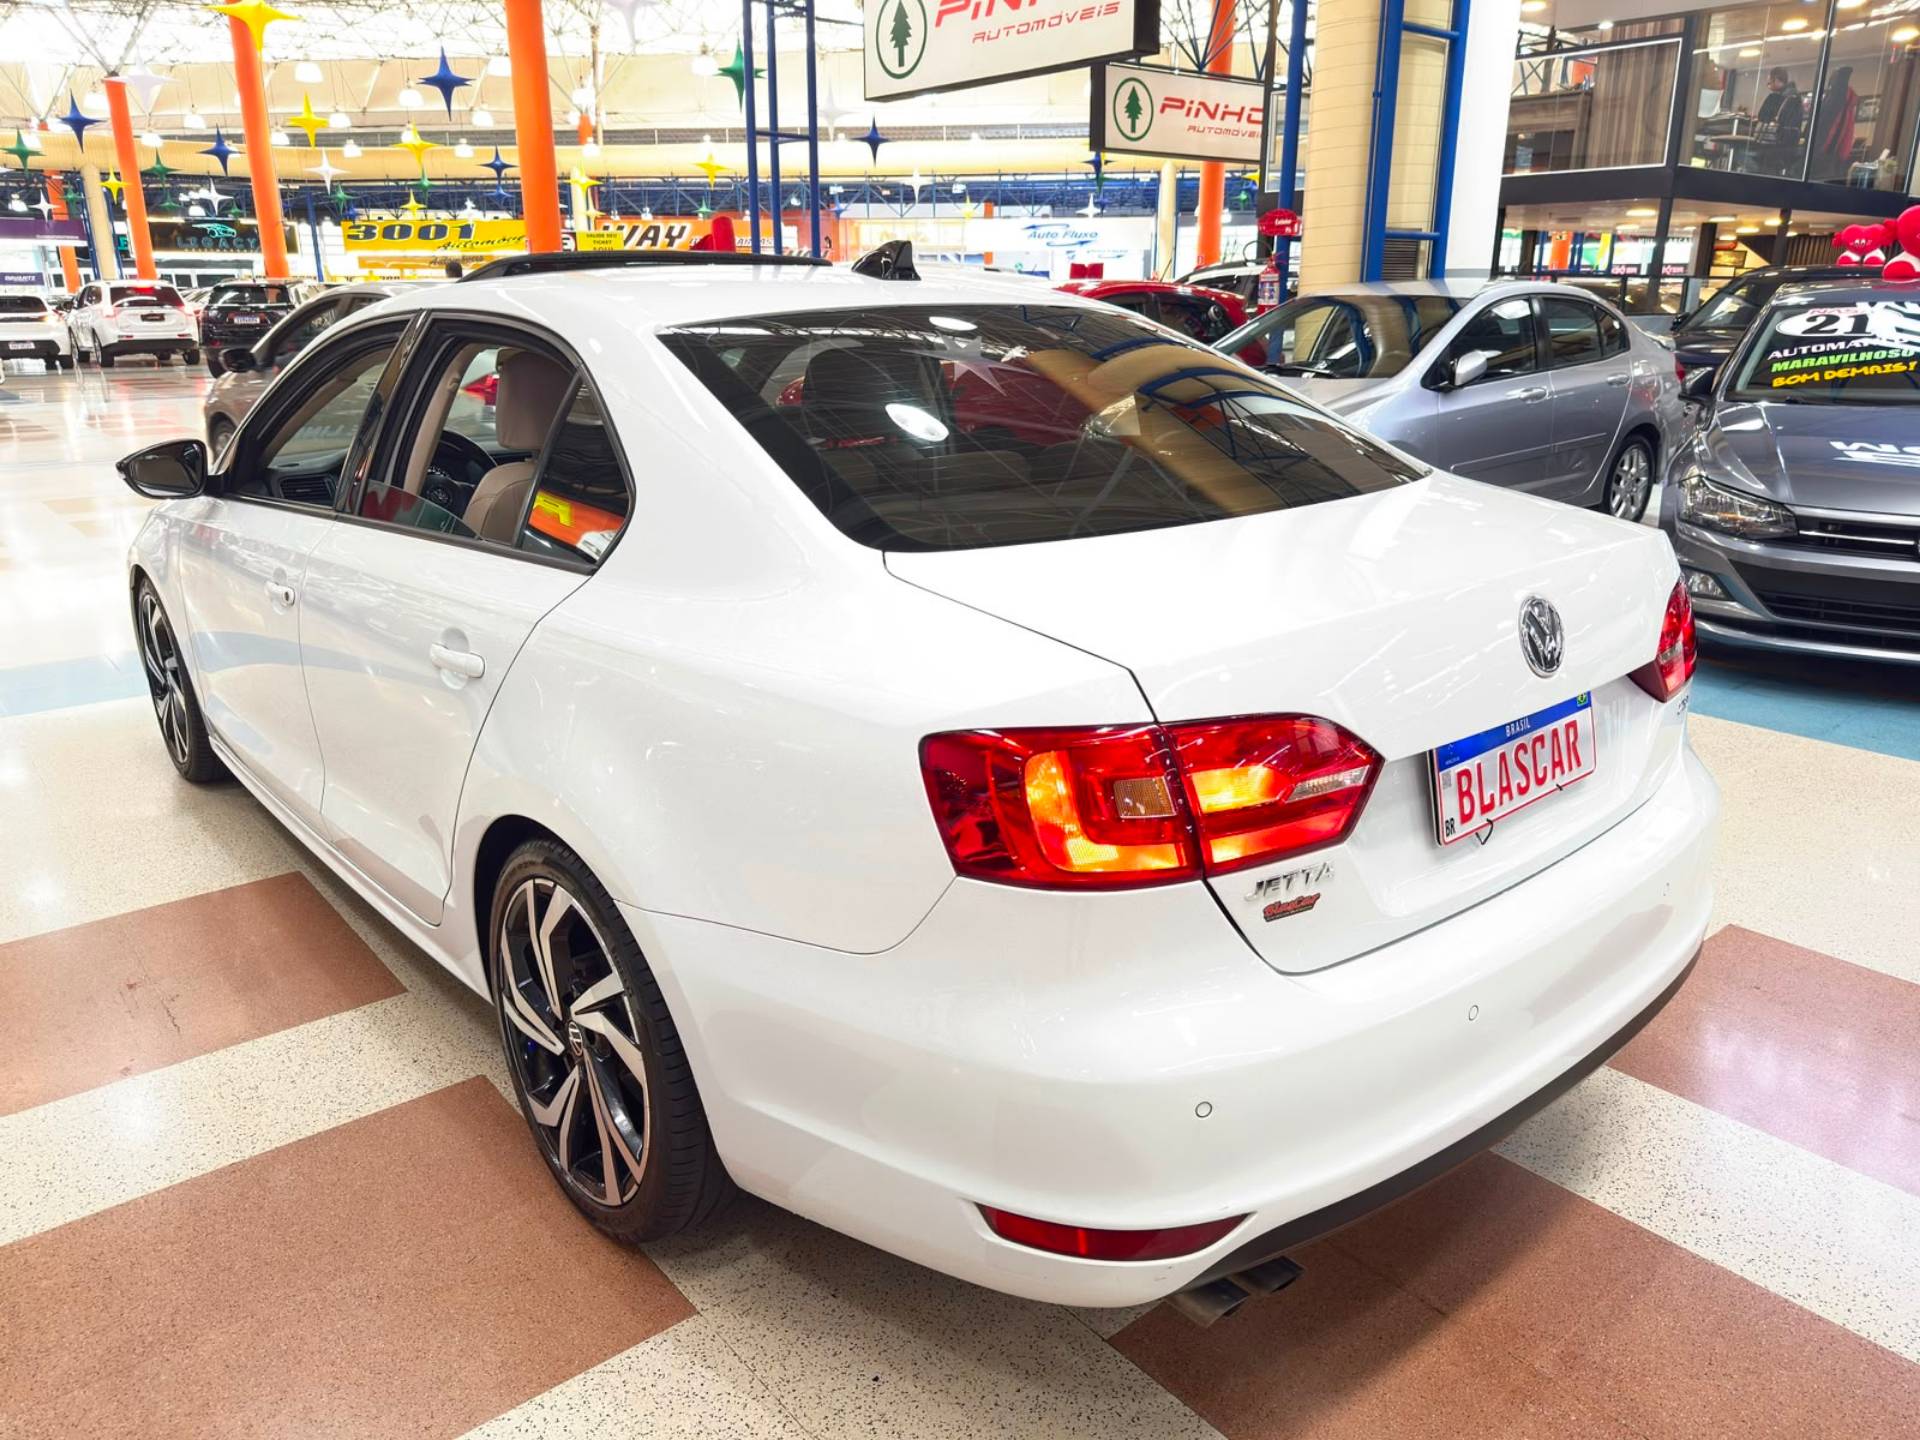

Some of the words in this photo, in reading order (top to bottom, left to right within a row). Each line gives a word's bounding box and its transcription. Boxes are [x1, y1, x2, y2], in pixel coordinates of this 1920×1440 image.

[935, 0, 1038, 28] PiN
[347, 223, 476, 241] 3001
[1028, 231, 1058, 239] Auto
[1062, 230, 1098, 239] Fluxo
[176, 236, 258, 249] LEGACY
[1801, 313, 1872, 334] 21
[1771, 349, 1915, 372] MARAVILHOSO
[1772, 372, 1820, 388] BOM
[1505, 717, 1531, 737] BRASIL
[1455, 719, 1582, 826] BLASCAR
[1445, 818, 1456, 837] BR
[1244, 862, 1335, 901] JETTA
